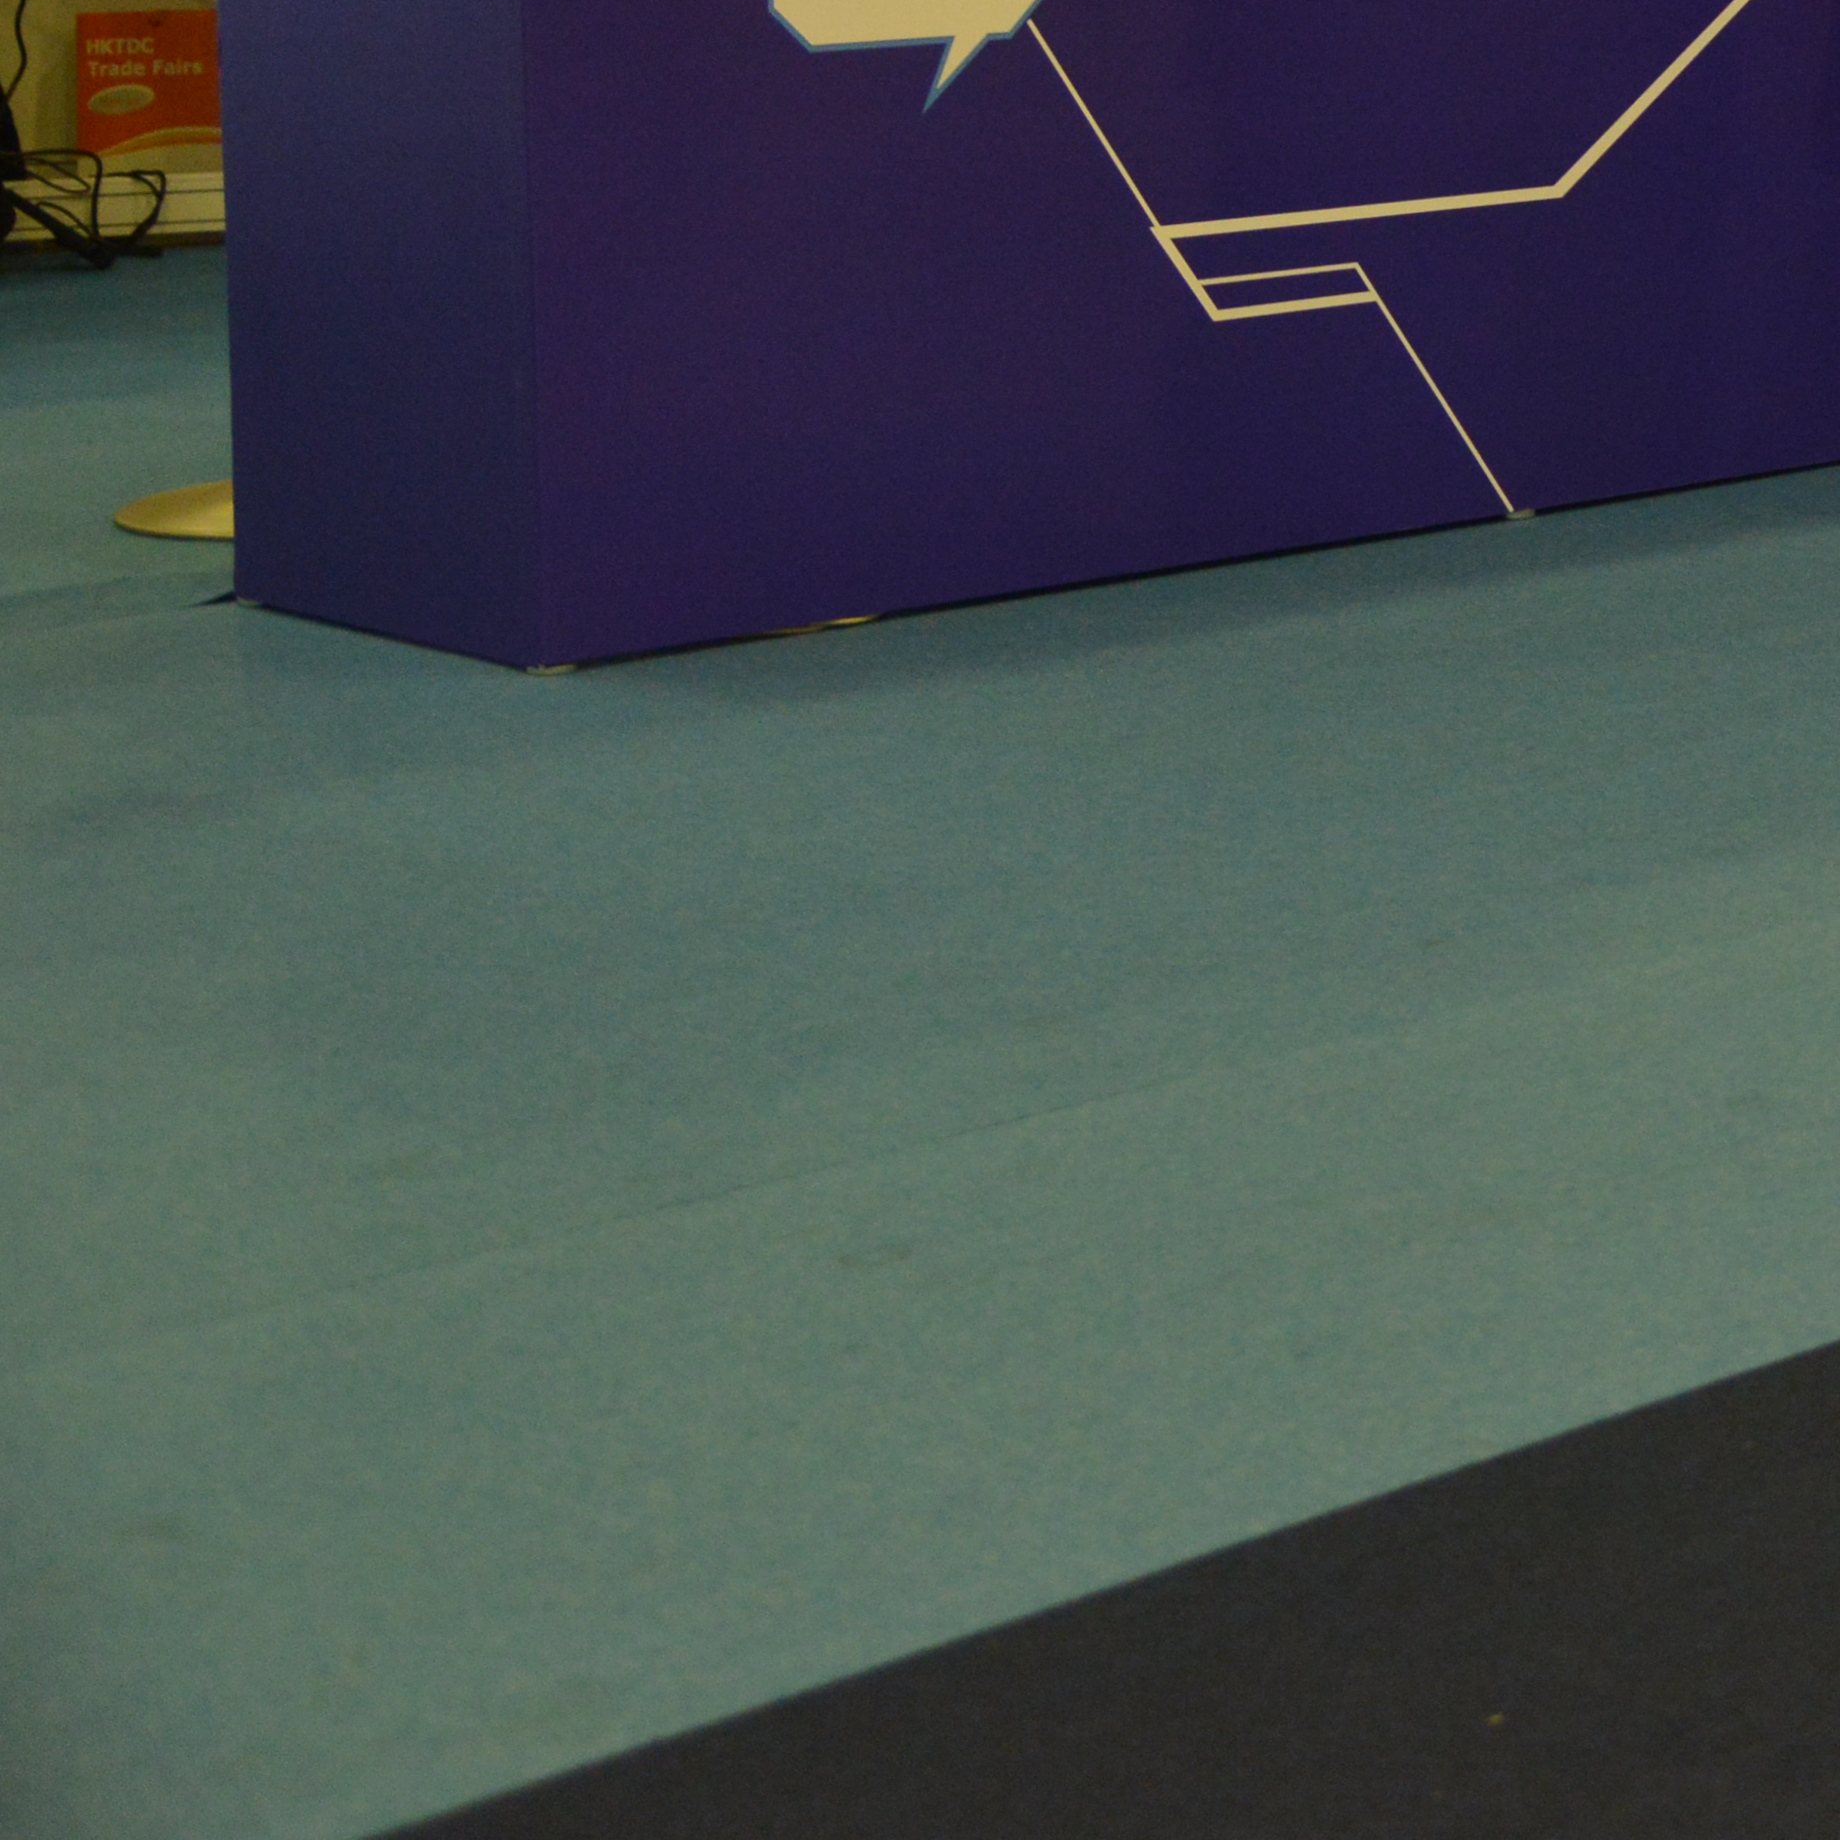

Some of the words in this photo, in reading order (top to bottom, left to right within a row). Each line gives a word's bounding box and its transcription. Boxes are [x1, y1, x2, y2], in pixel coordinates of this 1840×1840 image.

[86, 37, 155, 55] HKTDC
[88, 60, 146, 77] Trade
[152, 58, 204, 76] Fairs
